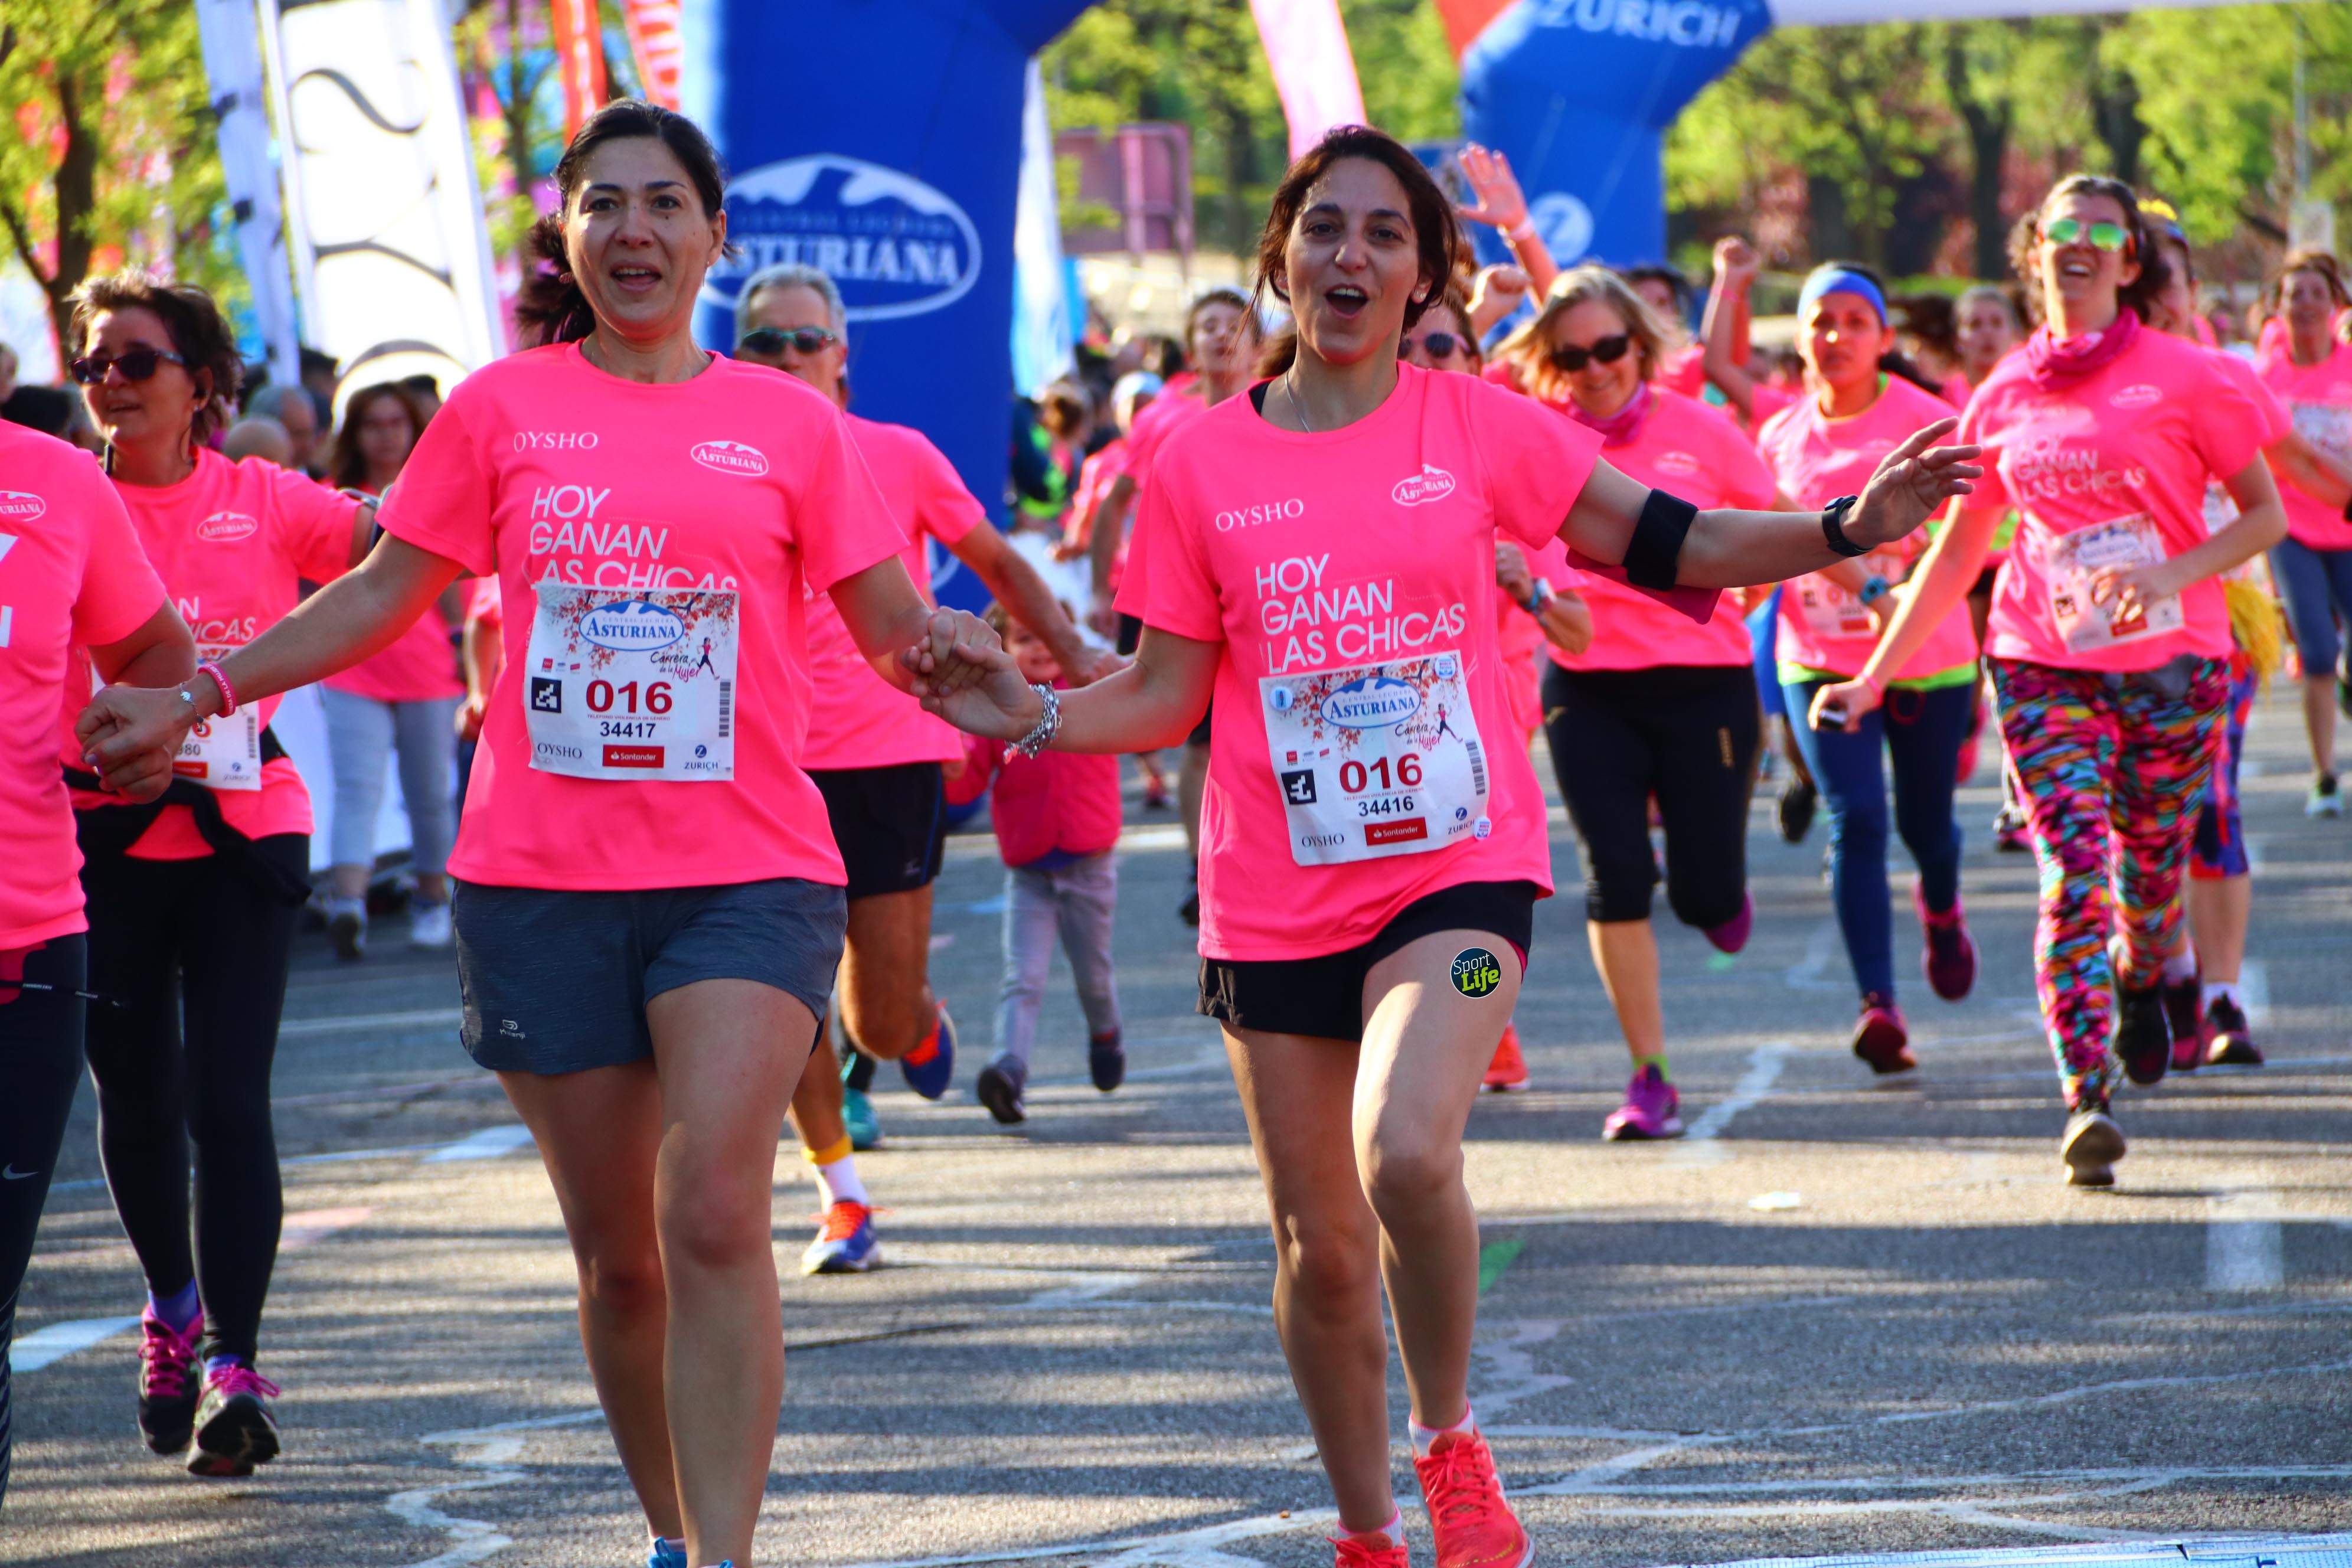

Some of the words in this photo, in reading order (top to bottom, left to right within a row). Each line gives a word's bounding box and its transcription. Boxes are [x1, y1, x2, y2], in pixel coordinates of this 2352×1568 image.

[1536, 0, 1741, 47] ZURICH
[514, 432, 599, 453] OYSHO
[697, 447, 763, 472] ASTURIANA
[0, 504, 41, 515] URIANA
[531, 485, 610, 518] HOY
[1216, 499, 1304, 531] OYSHO
[530, 522, 668, 559] GANAN
[533, 560, 583, 584] AS
[1256, 553, 1329, 599] HOY
[1261, 579, 1392, 635] GANAN
[190, 617, 256, 642] ICAS
[586, 617, 676, 638] ASTURIANA
[1268, 629, 1326, 674] LAS
[1336, 603, 1465, 658] CHICAS
[651, 651, 688, 664] Carrera
[672, 662, 701, 682] Mujer
[586, 680, 672, 714] 016
[1330, 696, 1415, 719] ASTURIANA
[600, 721, 656, 738] 34417
[1395, 724, 1428, 737] Carrera
[537, 741, 582, 760] OYSHO
[1418, 732, 1440, 751] Mujer
[620, 752, 656, 762] Santander
[685, 762, 718, 771] ZURICH
[1340, 753, 1423, 793] 016
[1358, 796, 1414, 816] 34416
[1383, 826, 1419, 837] Santander
[1448, 818, 1475, 835] ZURICH
[1302, 832, 1344, 848] OYSHO
[1453, 953, 1491, 975] Sport
[1461, 966, 1500, 992] Life
